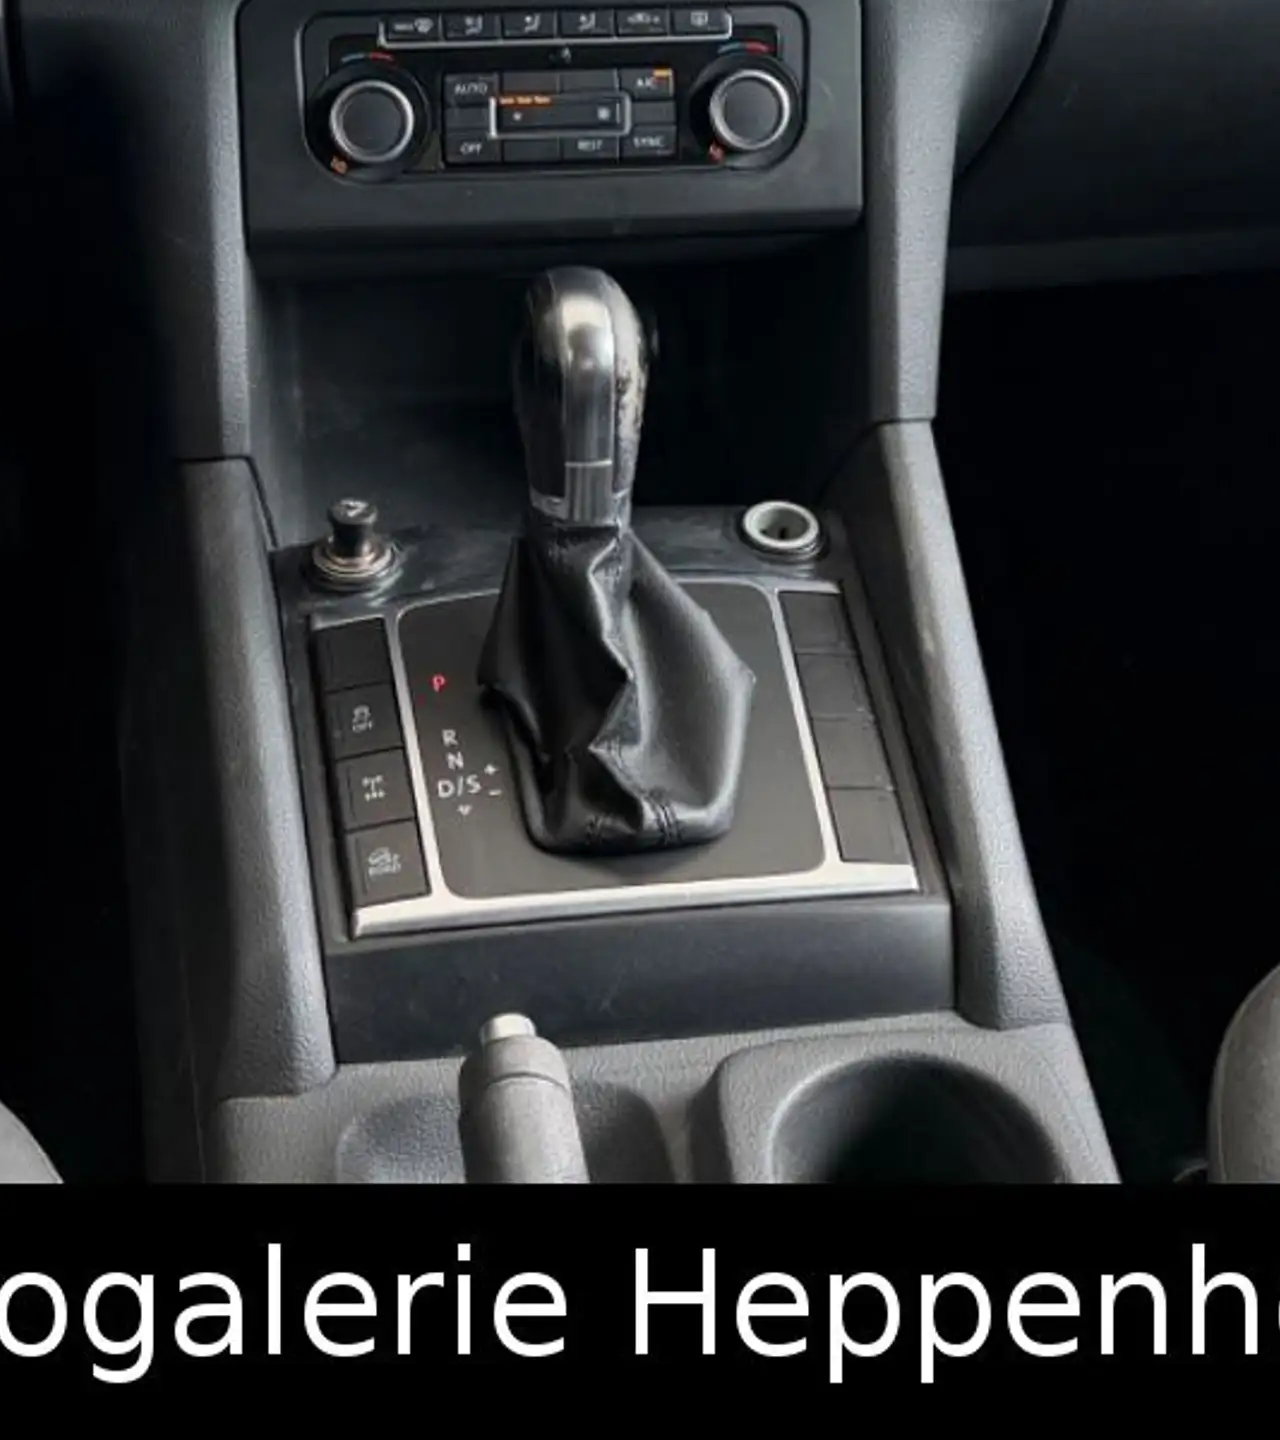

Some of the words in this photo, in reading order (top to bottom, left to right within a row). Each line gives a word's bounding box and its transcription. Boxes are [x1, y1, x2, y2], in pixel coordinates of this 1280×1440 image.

[454, 82, 488, 95] AUTO
[460, 142, 483, 155] OFF
[633, 135, 665, 150] SYNC
[432, 674, 447, 692] P
[442, 729, 458, 747] R
[447, 751, 464, 770] N
[437, 773, 482, 798] D/S
